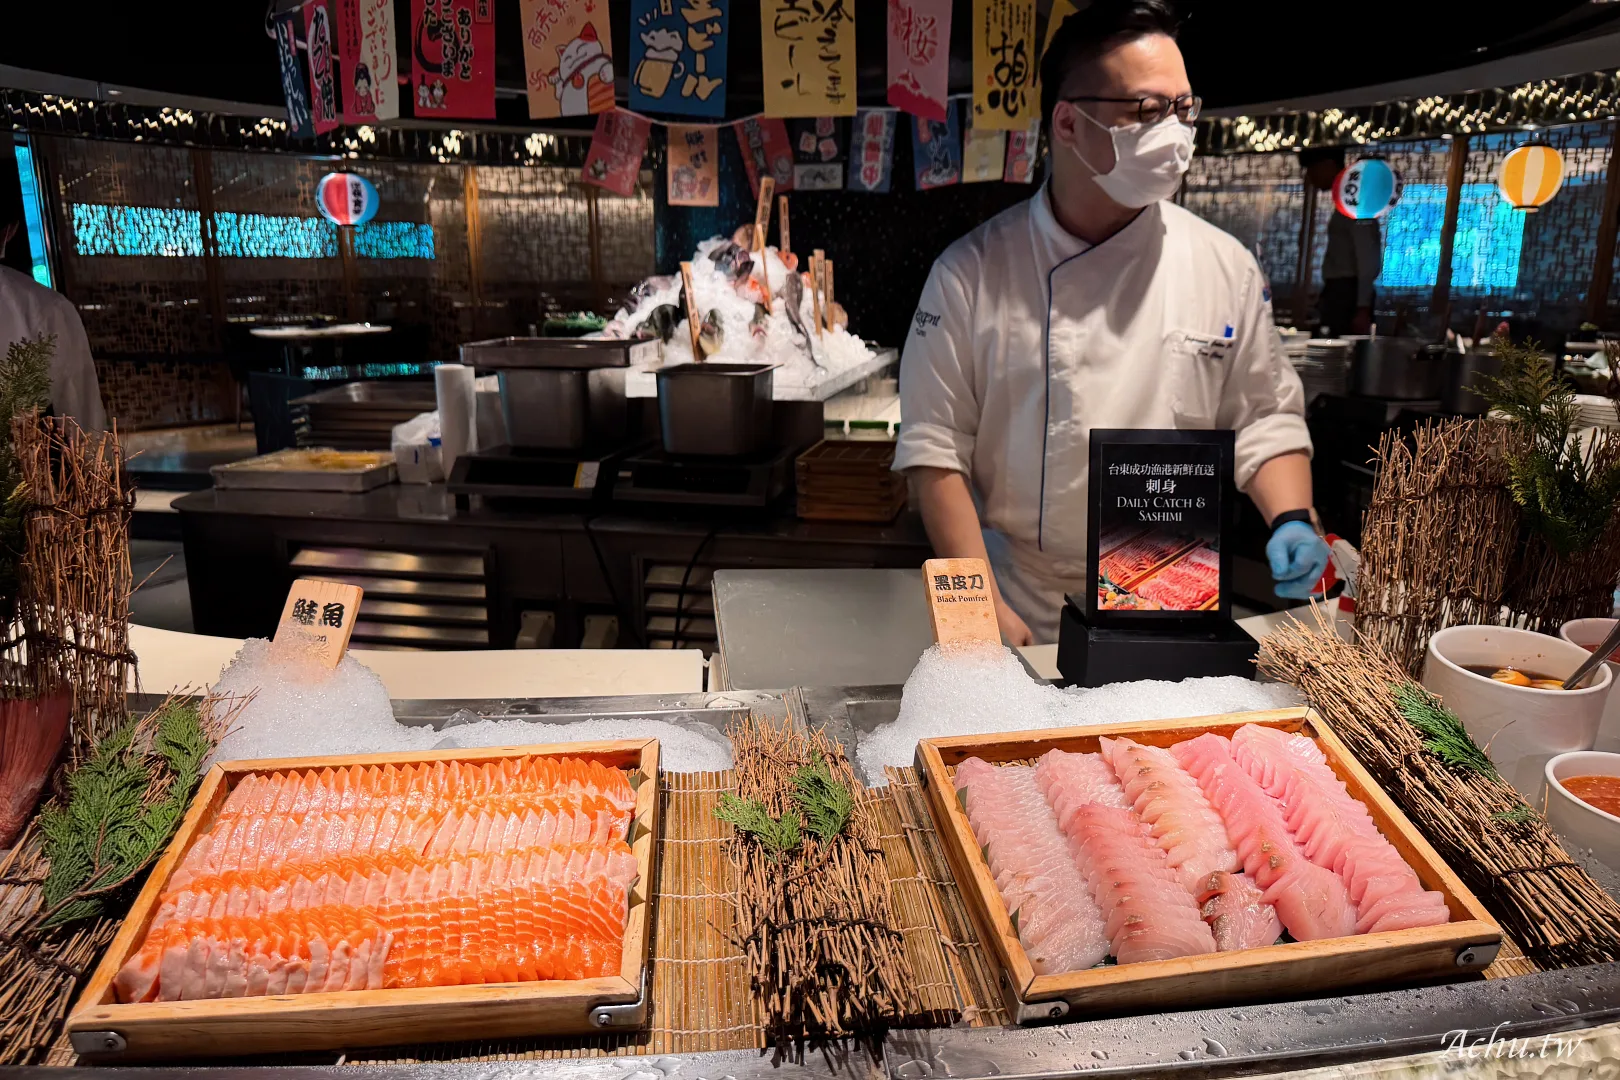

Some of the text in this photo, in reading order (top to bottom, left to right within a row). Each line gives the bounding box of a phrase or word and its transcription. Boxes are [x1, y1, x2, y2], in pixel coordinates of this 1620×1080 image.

[457, 8, 473, 79] ありがと
[903, 6, 938, 65] 桜
[1108, 463, 1215, 476] 台東成功漁港新鮮直送
[1145, 478, 1177, 494] 刺身
[1195, 496, 1206, 508] &
[936, 594, 988, 603] Black Pomfret
[291, 597, 345, 629] 鮭魚
